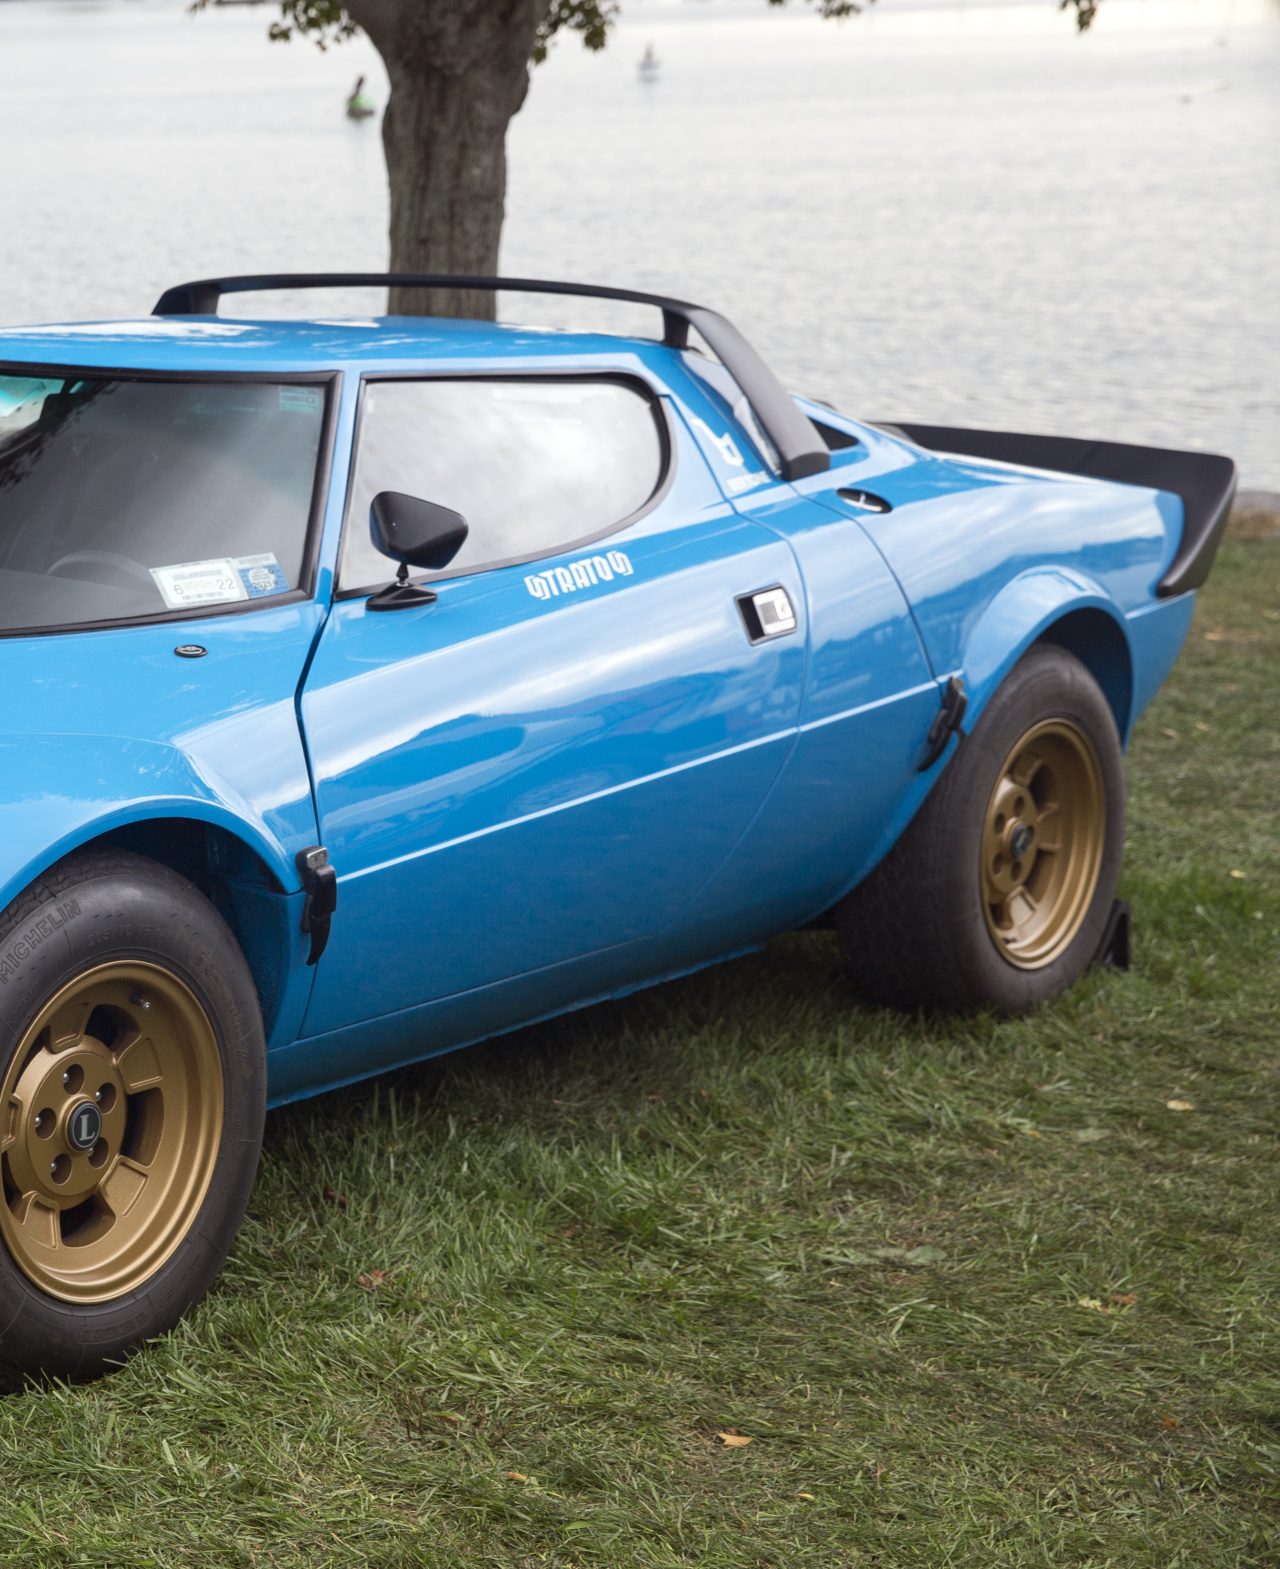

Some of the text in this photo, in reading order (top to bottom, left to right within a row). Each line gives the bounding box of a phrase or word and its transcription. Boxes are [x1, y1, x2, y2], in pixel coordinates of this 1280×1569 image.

[173, 577, 236, 595] 6 22
[524, 550, 634, 600] STRATOS
[79, 1114, 96, 1141] L
